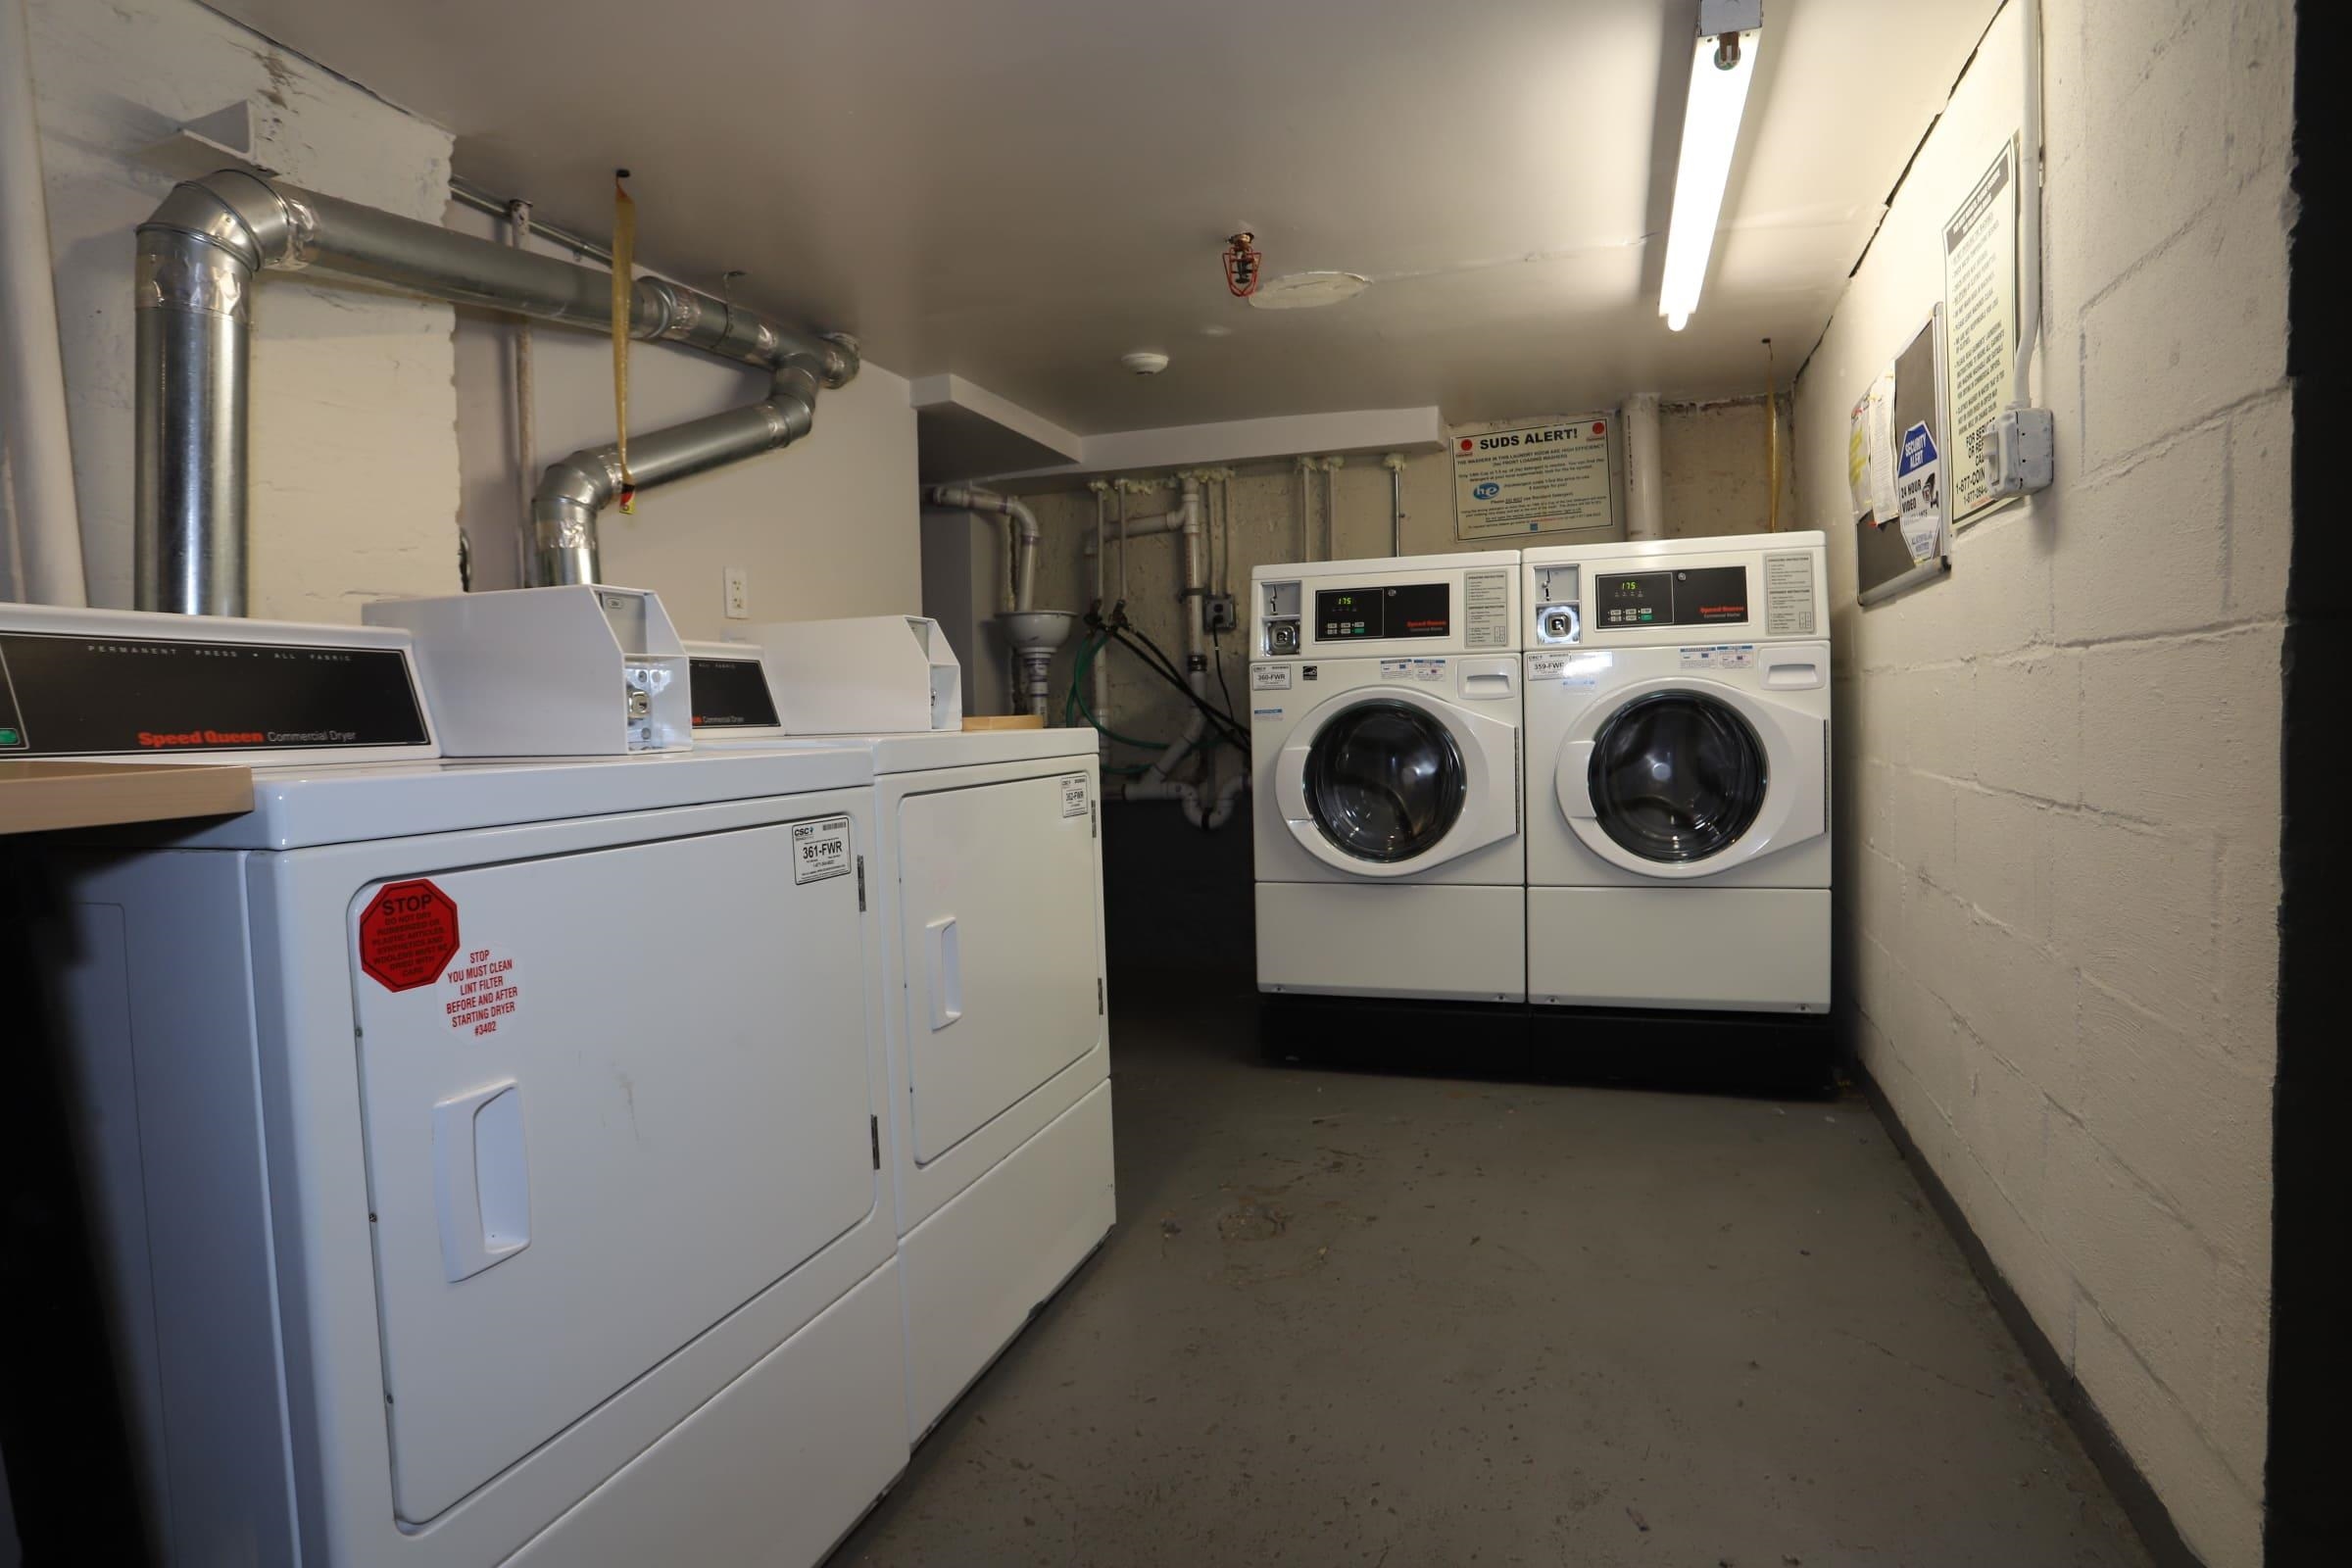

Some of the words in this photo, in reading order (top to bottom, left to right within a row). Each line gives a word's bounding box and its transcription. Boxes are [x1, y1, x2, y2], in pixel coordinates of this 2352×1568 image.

[1480, 435, 1520, 450] SUDS
[1525, 427, 1578, 444] ALERT!
[1905, 432, 1927, 458] SECURITY
[1966, 432, 1975, 447] FOR
[1910, 450, 1924, 468] ALERT
[1968, 444, 1975, 459] OR
[1901, 486, 1907, 499] 24
[1908, 479, 1922, 494] HOUR
[1901, 497, 1917, 514] VIDEO
[88, 645, 176, 655] PERMANENT
[138, 730, 203, 749] Speed
[204, 729, 265, 744] Queen
[267, 730, 328, 742] Commercial
[328, 730, 357, 743] Dryer
[794, 827, 809, 836] CSC
[803, 841, 843, 859] 361-FWR
[382, 894, 432, 916] STOP
[470, 950, 490, 963] STOP
[448, 970, 465, 983] YOU
[466, 964, 487, 979] MUST
[489, 958, 513, 974] CLEAN
[460, 981, 477, 996] LINT
[479, 976, 504, 991] FILTER
[446, 997, 476, 1014] BEFORE
[478, 993, 494, 1005] AND
[496, 986, 518, 1001] AFTER
[452, 1008, 489, 1027] STARTING
[491, 1001, 515, 1017] DRYER
[474, 1020, 497, 1036] #3402
